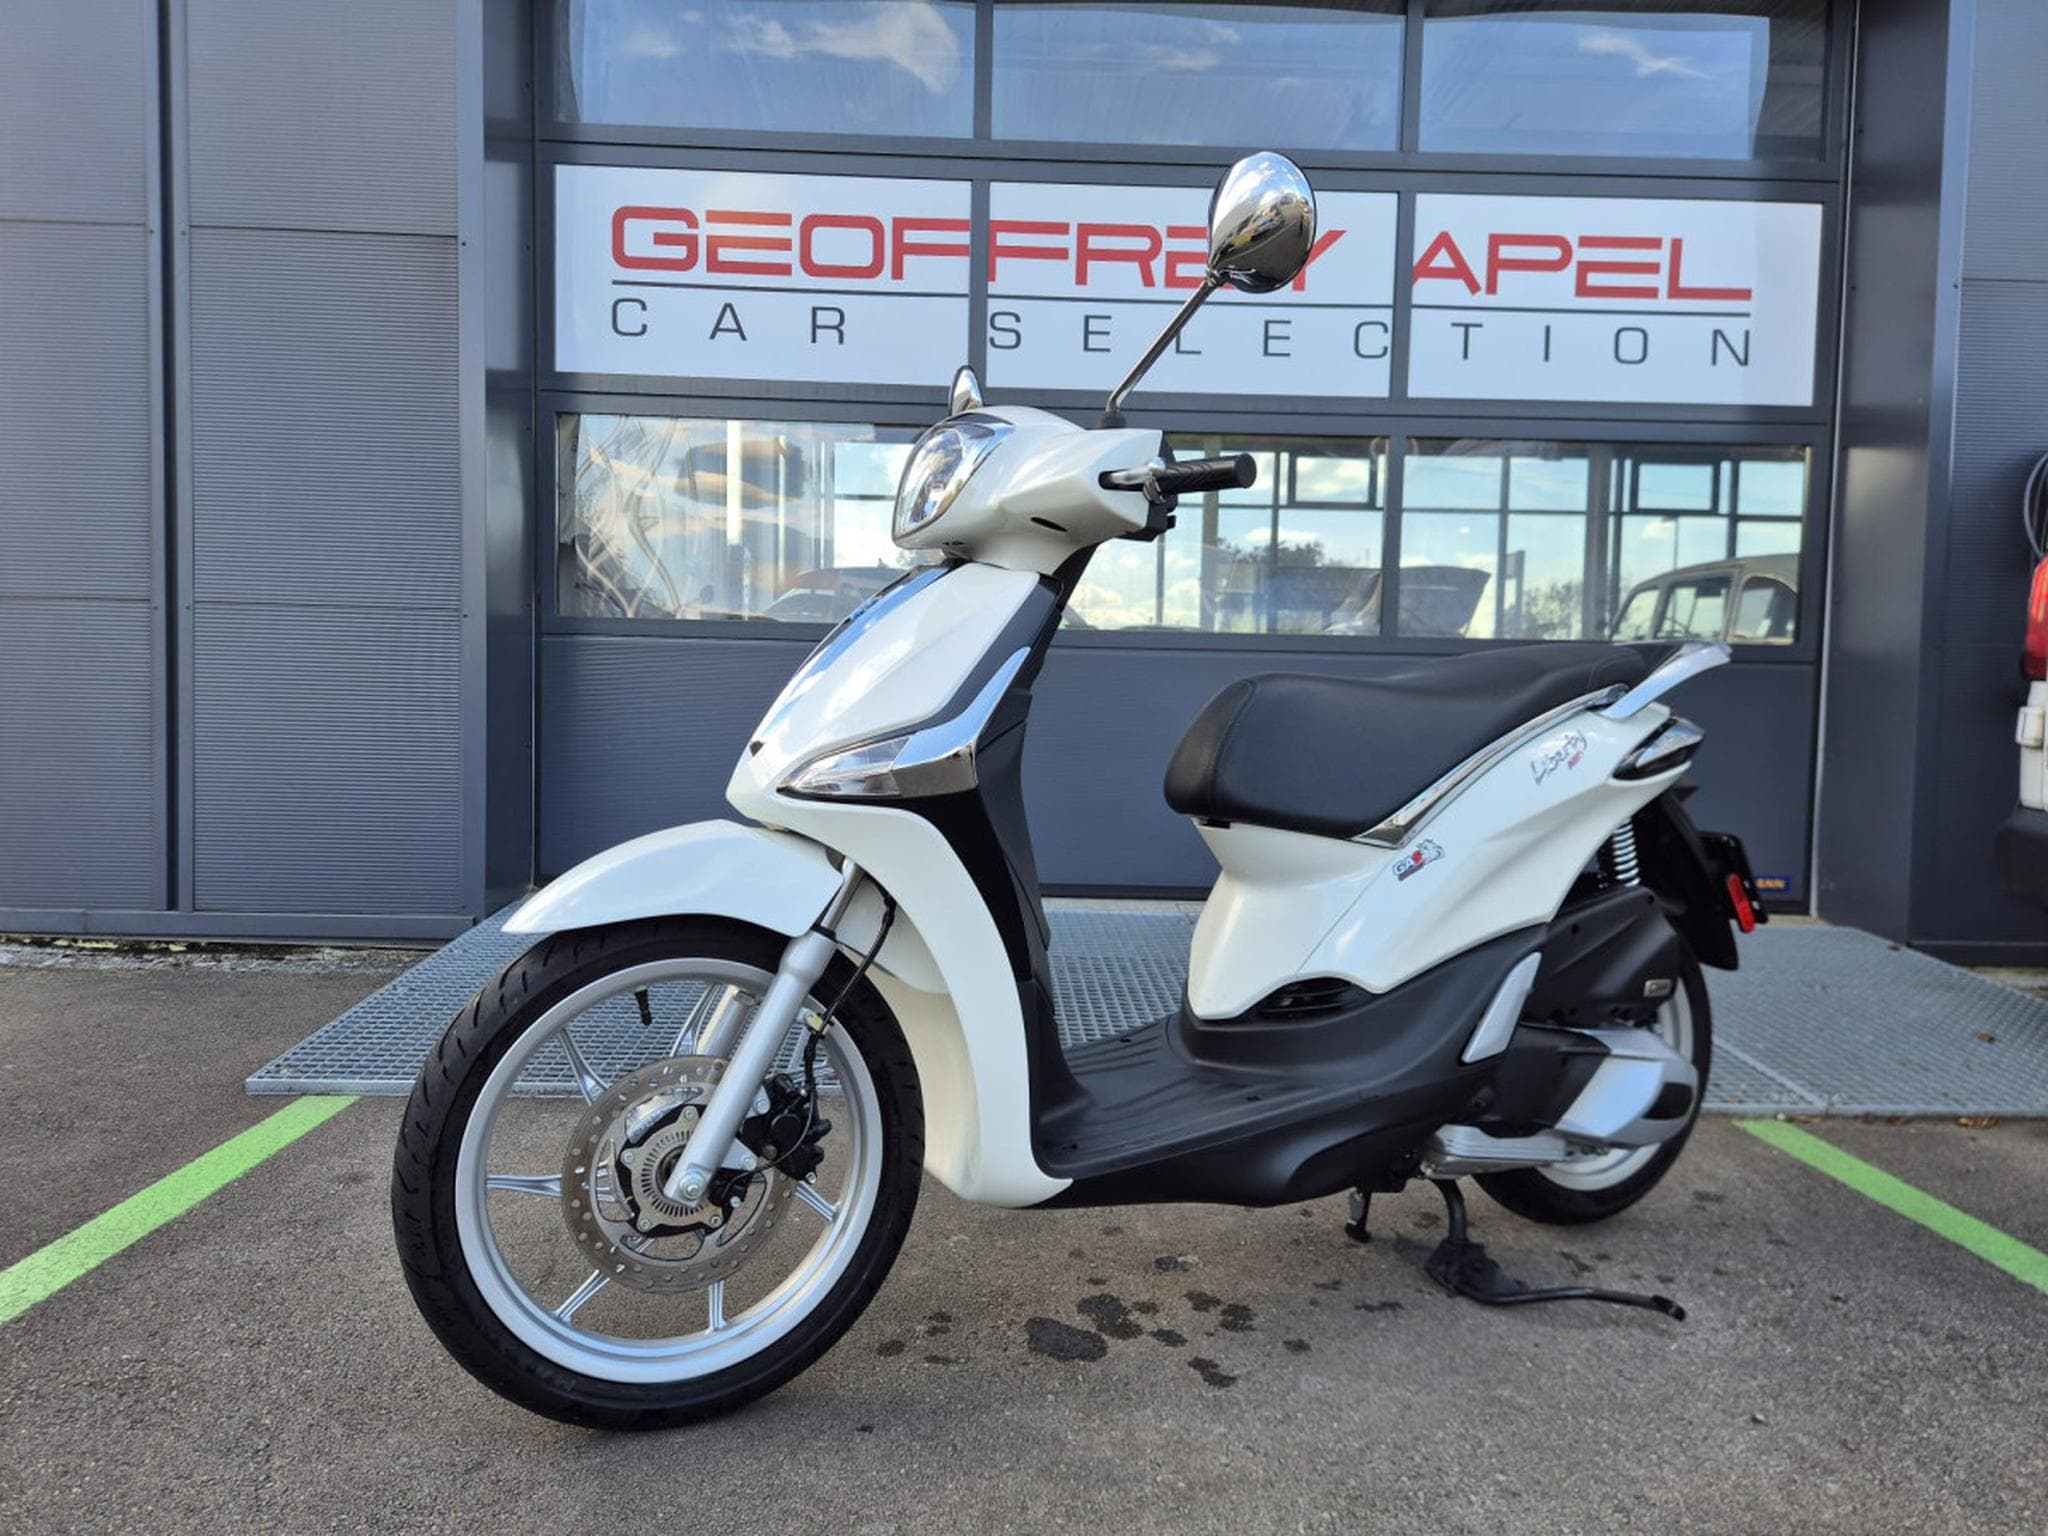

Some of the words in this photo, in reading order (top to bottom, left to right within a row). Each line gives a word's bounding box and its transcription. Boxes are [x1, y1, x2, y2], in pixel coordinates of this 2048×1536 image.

[1411, 230, 1752, 300] APEL
[611, 297, 845, 345] CAR
[987, 311, 1751, 367] SELECTION
